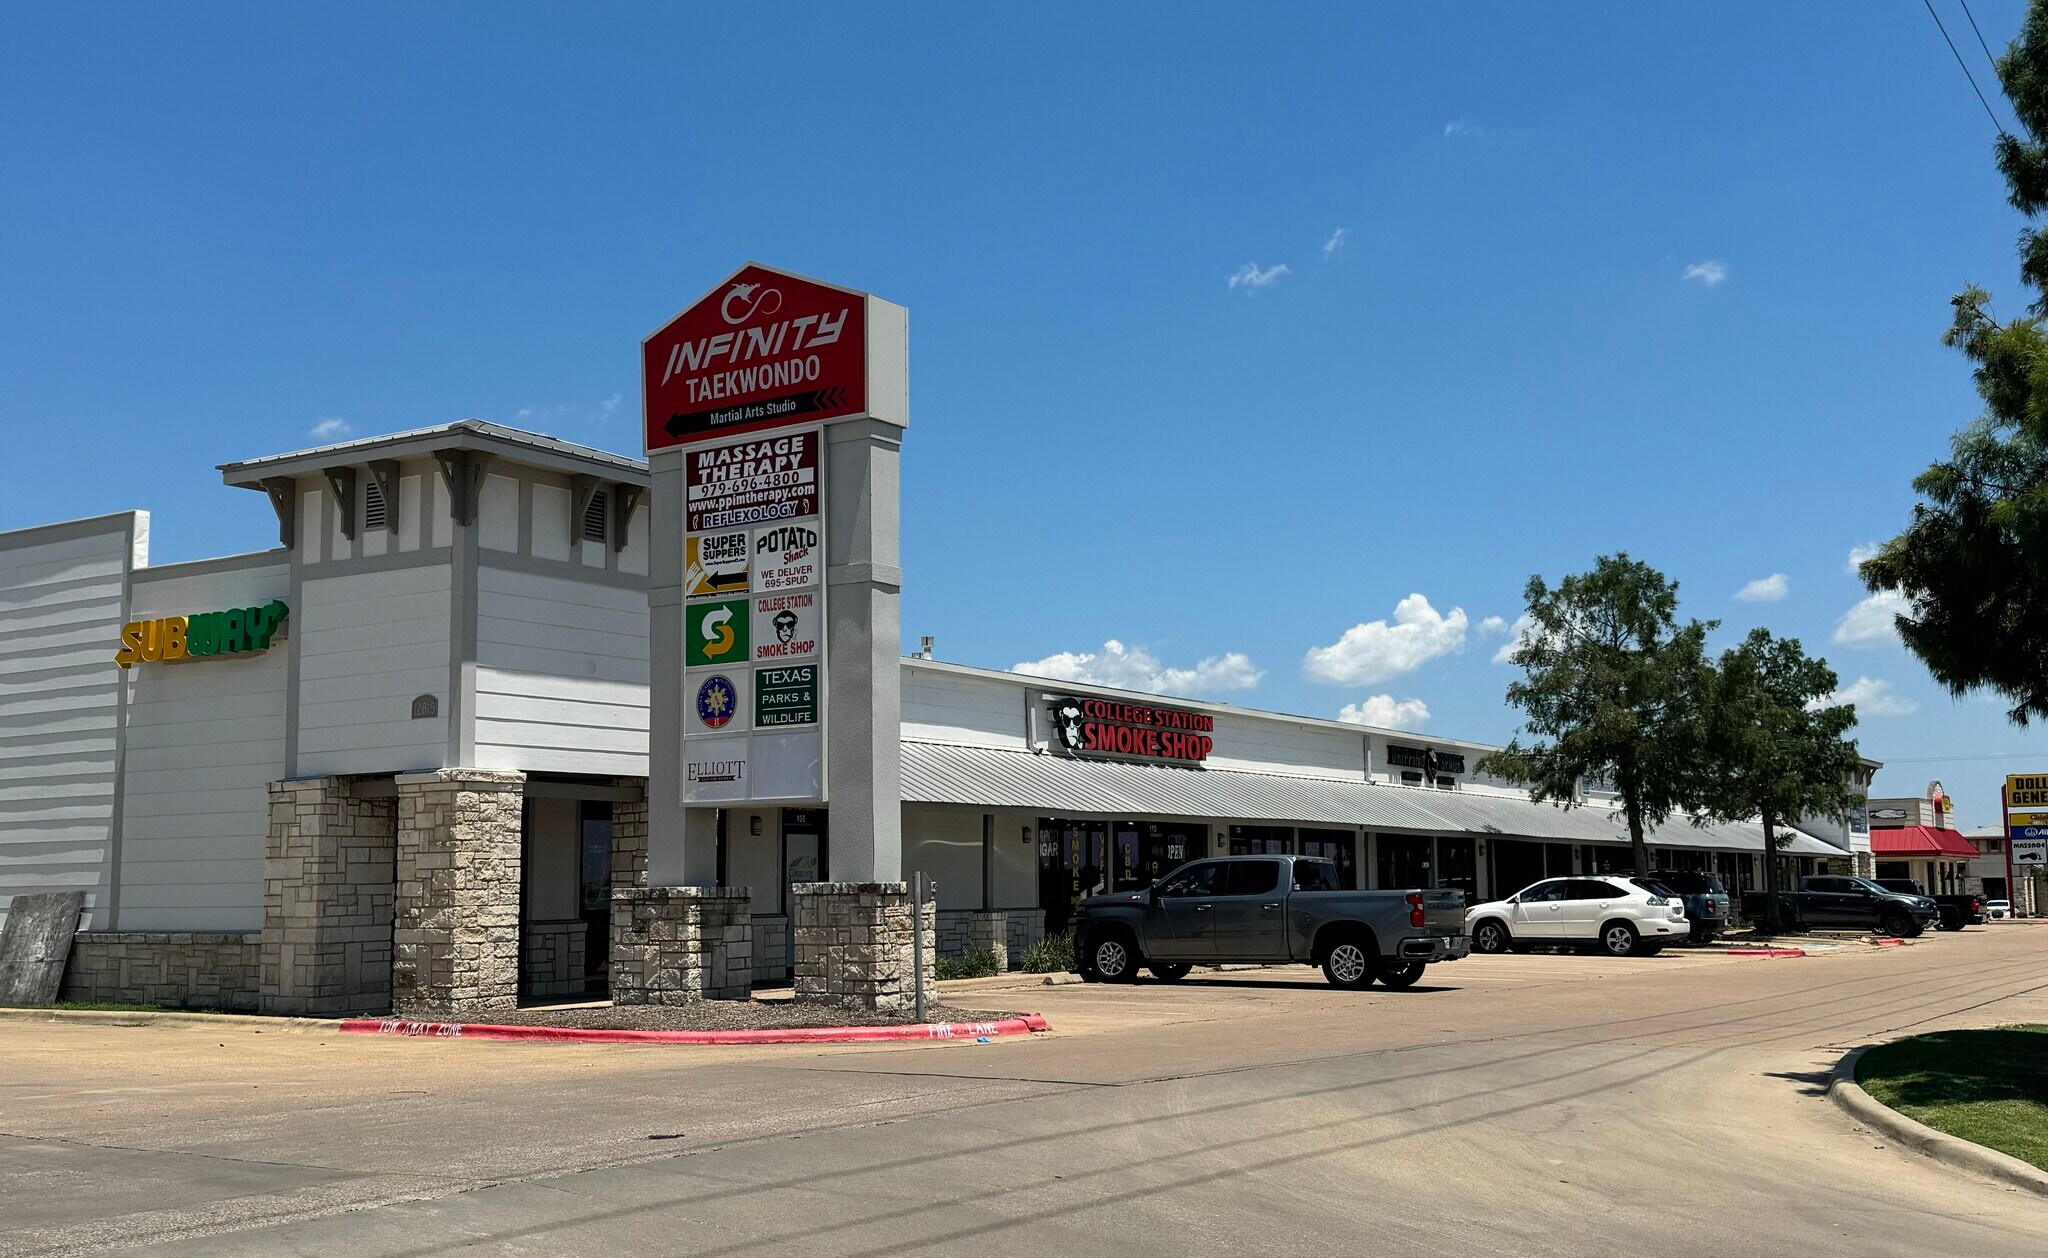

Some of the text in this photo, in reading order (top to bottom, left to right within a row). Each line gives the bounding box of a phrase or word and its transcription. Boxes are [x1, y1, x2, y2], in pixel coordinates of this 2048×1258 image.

[661, 308, 848, 387] INFINITY
[686, 354, 820, 403] TAEKWONDO
[710, 399, 796, 425] Martial Arts Studio
[698, 436, 804, 468] MASSAGE
[699, 453, 803, 484] THERAPY
[702, 471, 800, 498] 979-696-4800
[689, 484, 815, 513] www.ppimtherapy.com
[703, 501, 799, 529] REFLEXOLOGY
[703, 533, 746, 551] SUPER
[756, 527, 818, 555] POTATO
[703, 547, 746, 560] SUPPERS
[783, 543, 809, 565] Shack
[761, 565, 813, 579] WE DELIVER
[765, 575, 809, 589] 695-SPUD
[758, 593, 813, 613] COLLEGE STATION
[114, 599, 290, 670] SUBWAY
[757, 639, 815, 658] SMOKE SHOP
[762, 668, 811, 685] TEXAS
[762, 691, 811, 704] PARKS &
[762, 712, 811, 725] WILDLIFE
[1084, 699, 1214, 732] COLLEGE STATION
[1084, 722, 1214, 761] SMOKE SHOP
[687, 760, 745, 781] ELLIOTT
[2012, 791, 2048, 804] GENE
[1071, 826, 1081, 892] SMOKE
[1098, 834, 1106, 883] VAPE
[1124, 842, 1132, 880] CBD
[788, 868, 814, 879] Cleaning
[378, 1021, 462, 1036] TOW AWAY ZONE
[928, 1023, 998, 1037] FIRE LANE
